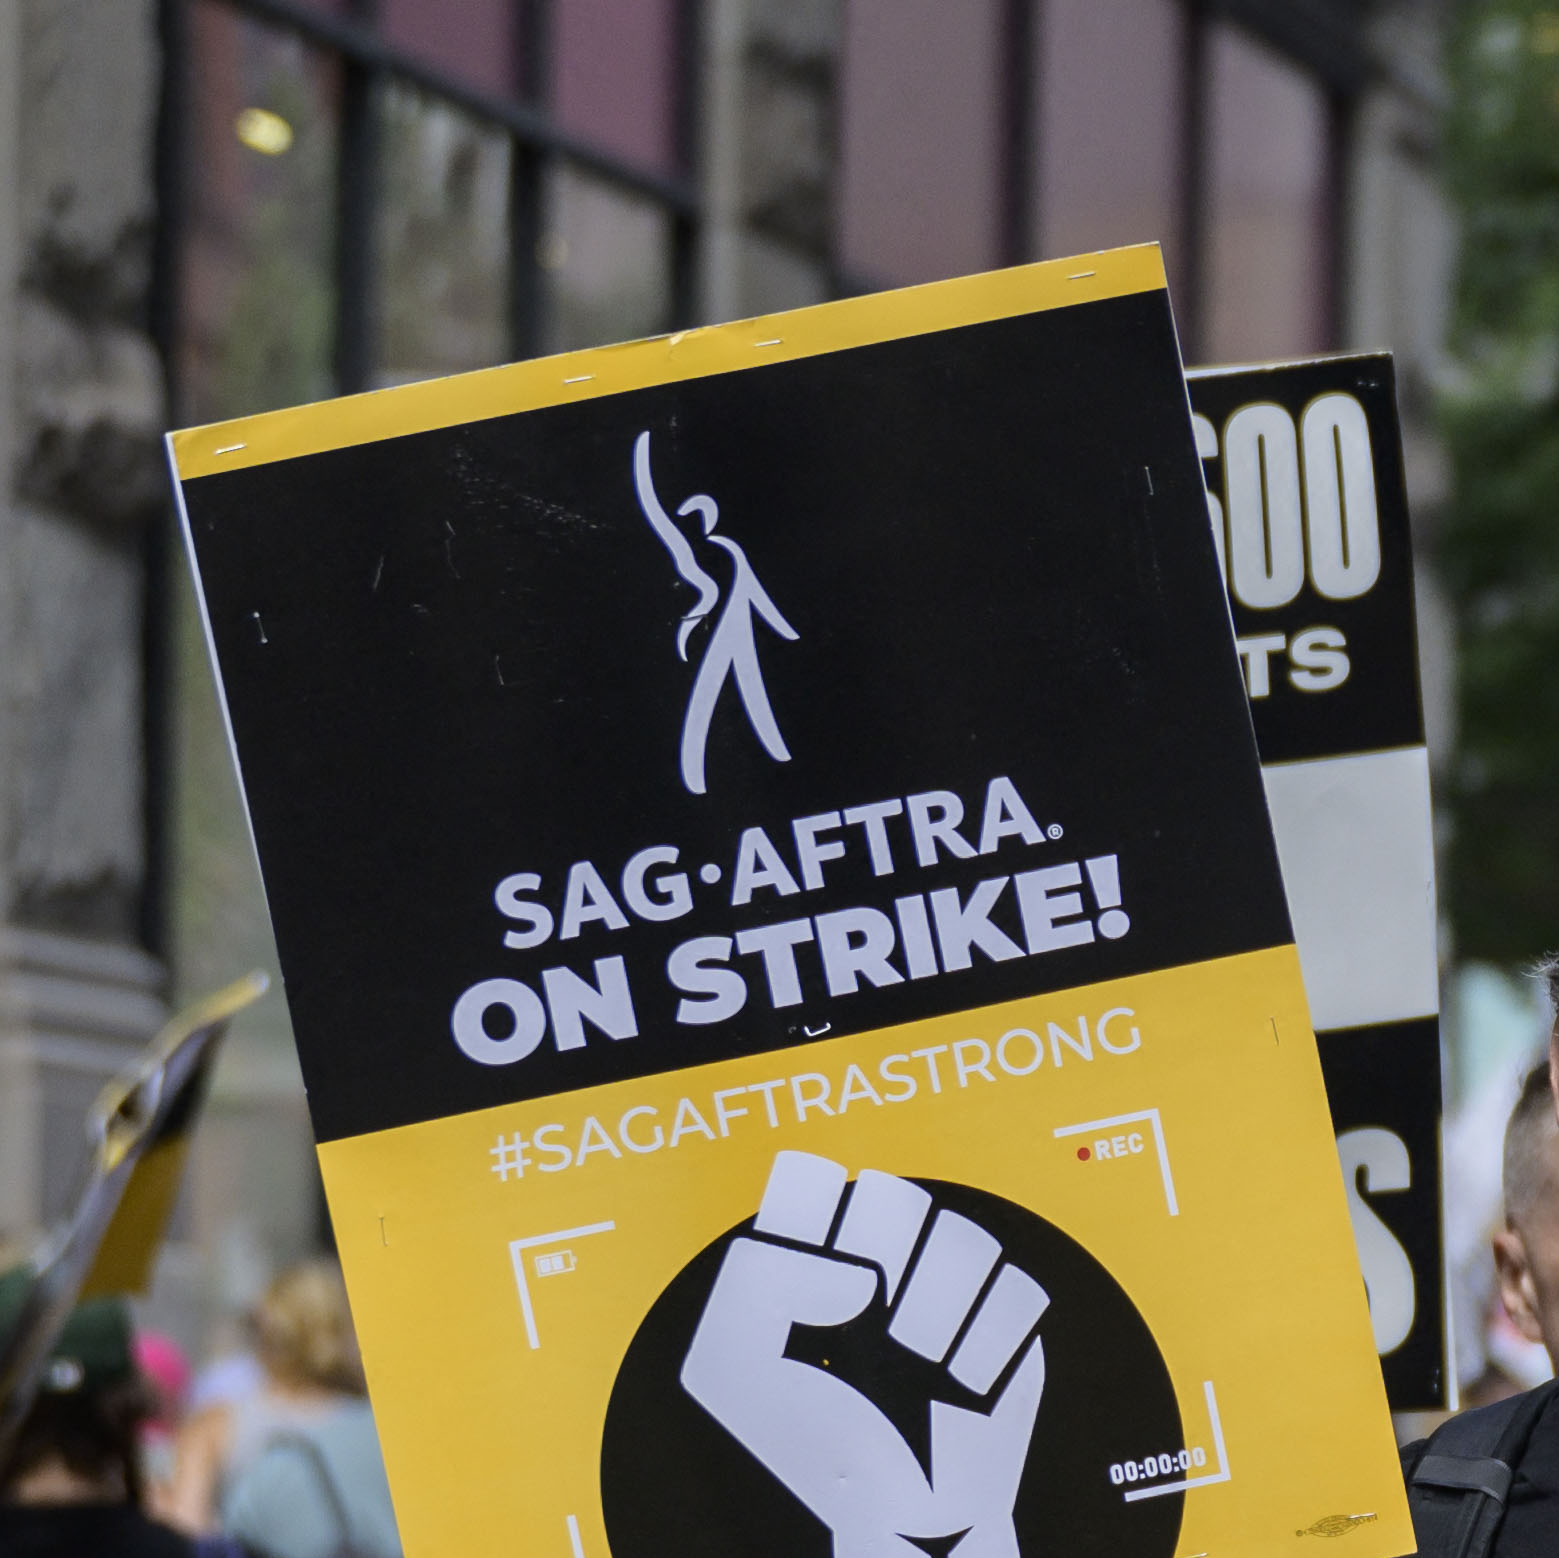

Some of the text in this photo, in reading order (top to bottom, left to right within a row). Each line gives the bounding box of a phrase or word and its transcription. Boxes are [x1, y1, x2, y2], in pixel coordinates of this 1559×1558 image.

[451, 854, 1130, 1066] ON STRIKE!
[488, 1007, 1142, 1182] #SAGAFTRASTRONG
[1094, 1132, 1144, 1161] REC
[1109, 1446, 1207, 1485] 00:00:00
